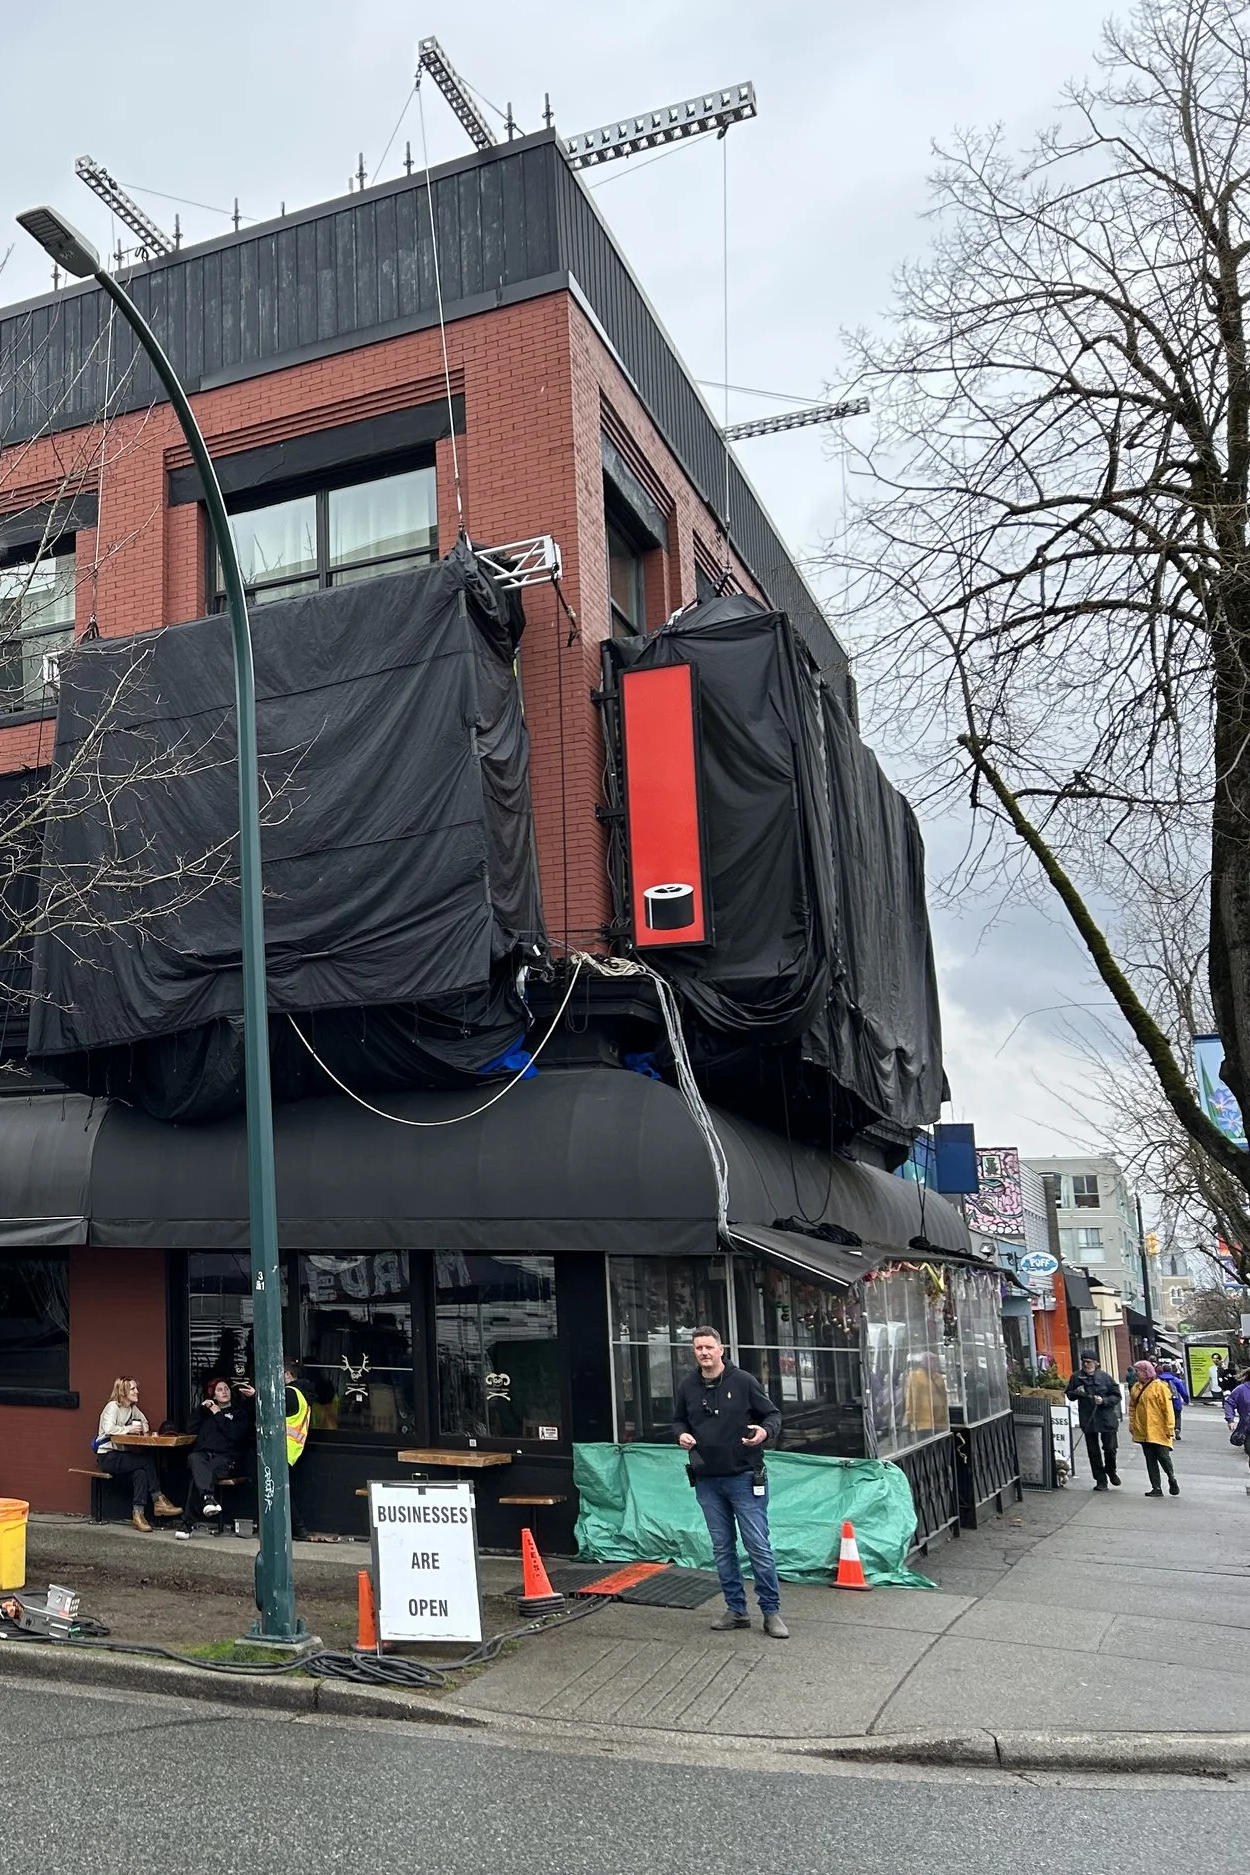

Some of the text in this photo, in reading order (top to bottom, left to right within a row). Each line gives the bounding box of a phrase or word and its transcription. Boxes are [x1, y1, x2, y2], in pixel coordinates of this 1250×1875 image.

[377, 1505, 469, 1524] BUSINESSES
[411, 1552, 440, 1570] ARE
[408, 1598, 449, 1617] OPEN
